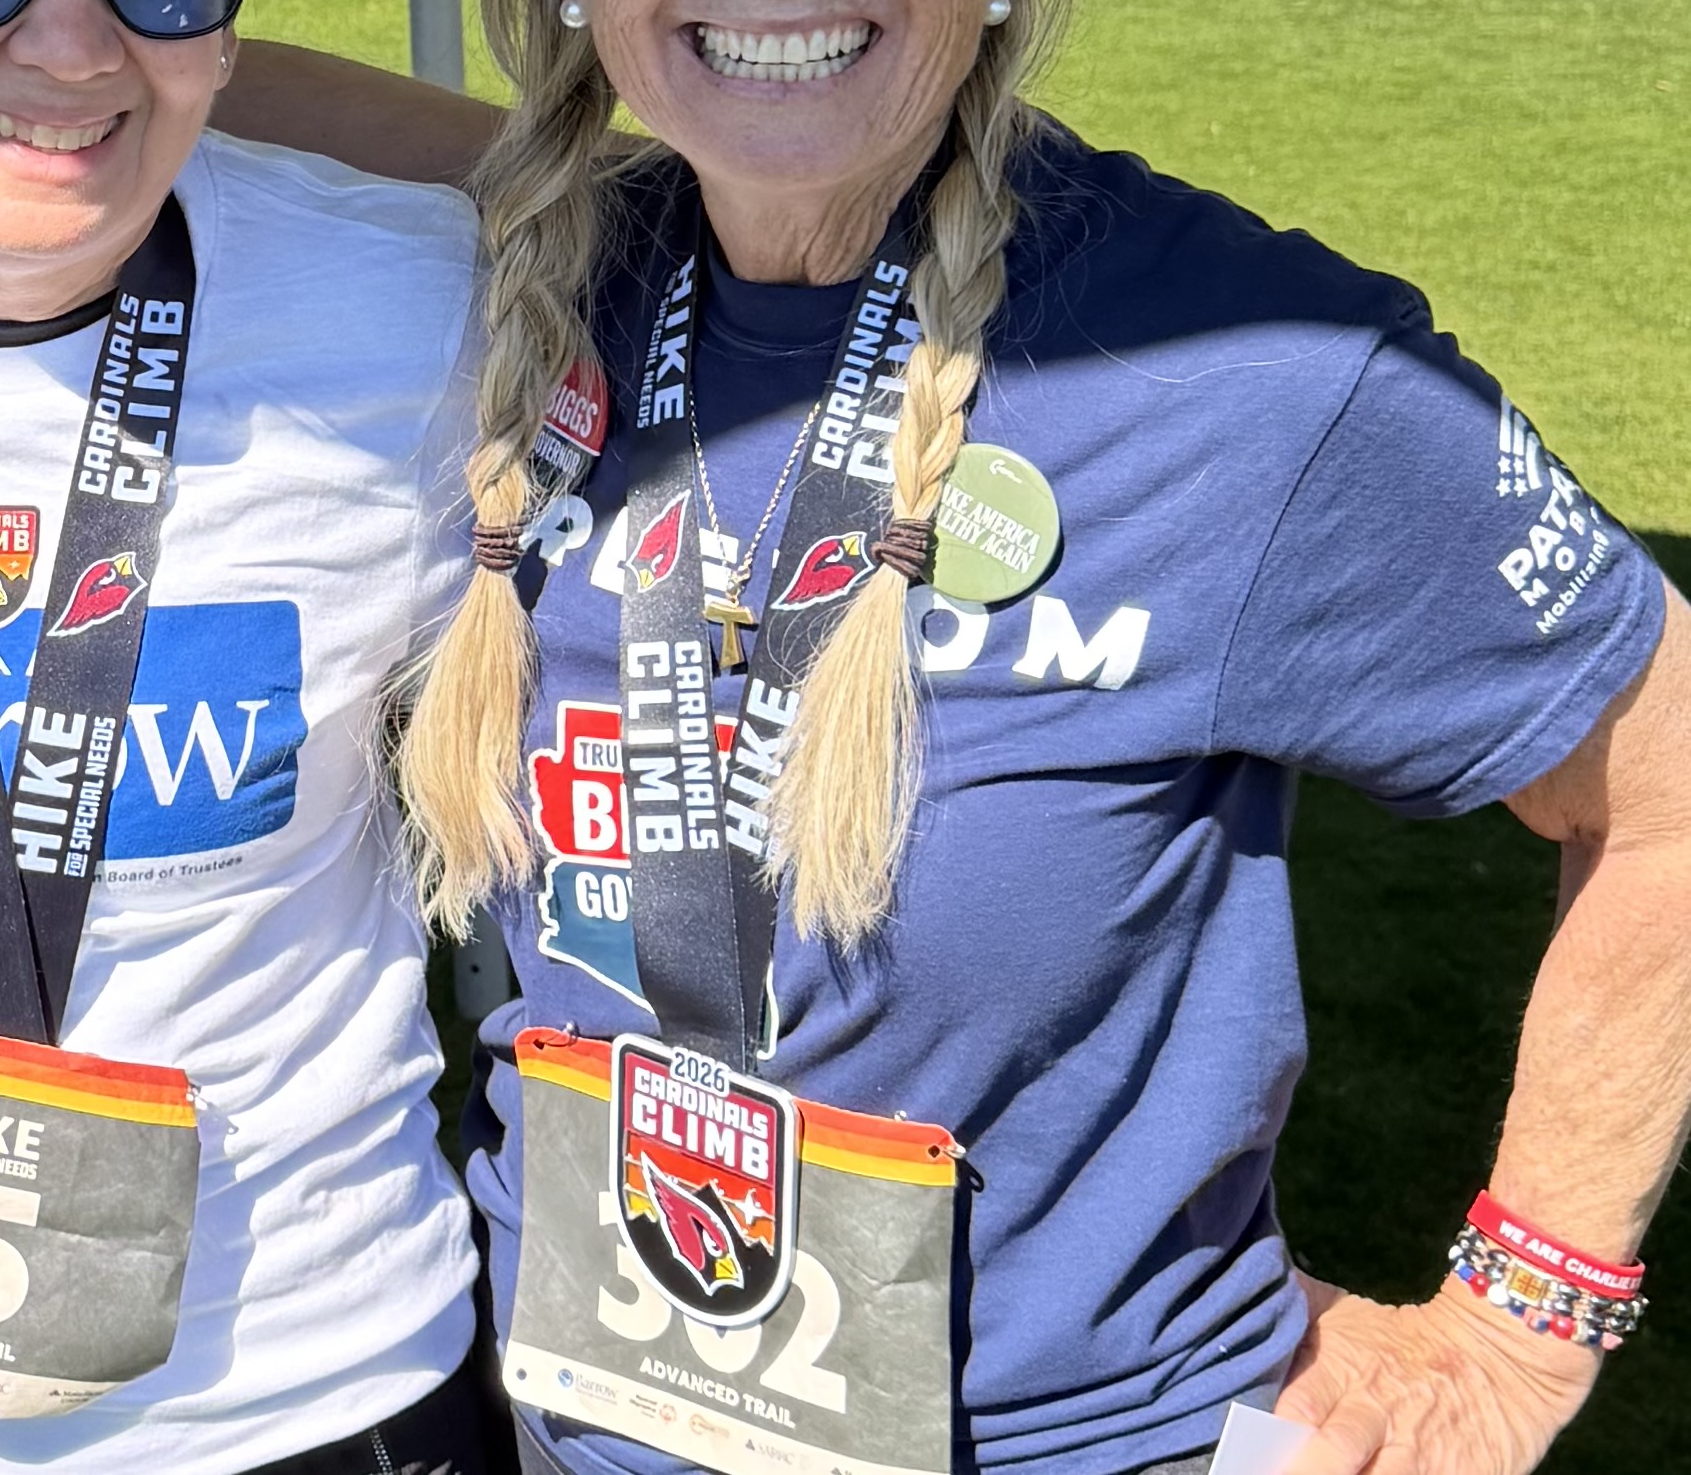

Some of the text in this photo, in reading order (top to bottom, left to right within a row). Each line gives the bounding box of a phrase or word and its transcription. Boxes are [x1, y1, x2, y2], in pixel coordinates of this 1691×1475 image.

[653, 254, 695, 425] HIKE
[811, 260, 908, 470] CARDINALS
[78, 293, 140, 495] CARDINALS
[110, 299, 185, 504] CLIMB
[637, 370, 655, 429] NEEDS
[535, 430, 581, 478] OVERNOR
[942, 483, 1041, 555] AKE AMERICA
[980, 534, 1037, 574] AGAIN
[85, 716, 116, 775] NEEDS
[627, 641, 684, 853] CLIMB
[674, 641, 719, 849] CARDINALS
[725, 678, 800, 854] HIKE
[11, 706, 87, 874] HIKE
[70, 778, 104, 851] SPECIAL
[108, 869, 153, 883] Board
[158, 866, 174, 879] of
[179, 855, 242, 876] Trustees
[634, 1067, 768, 1139] CARDINALS
[674, 1052, 725, 1093] 2026
[632, 1092, 769, 1180] CLIMB
[1499, 1220, 1527, 1245] WE
[1525, 1238, 1565, 1265] ARE
[1565, 1258, 1631, 1290] CHARLIE
[639, 1357, 740, 1407] ADVANCED
[743, 1393, 796, 1429] TRAIL
